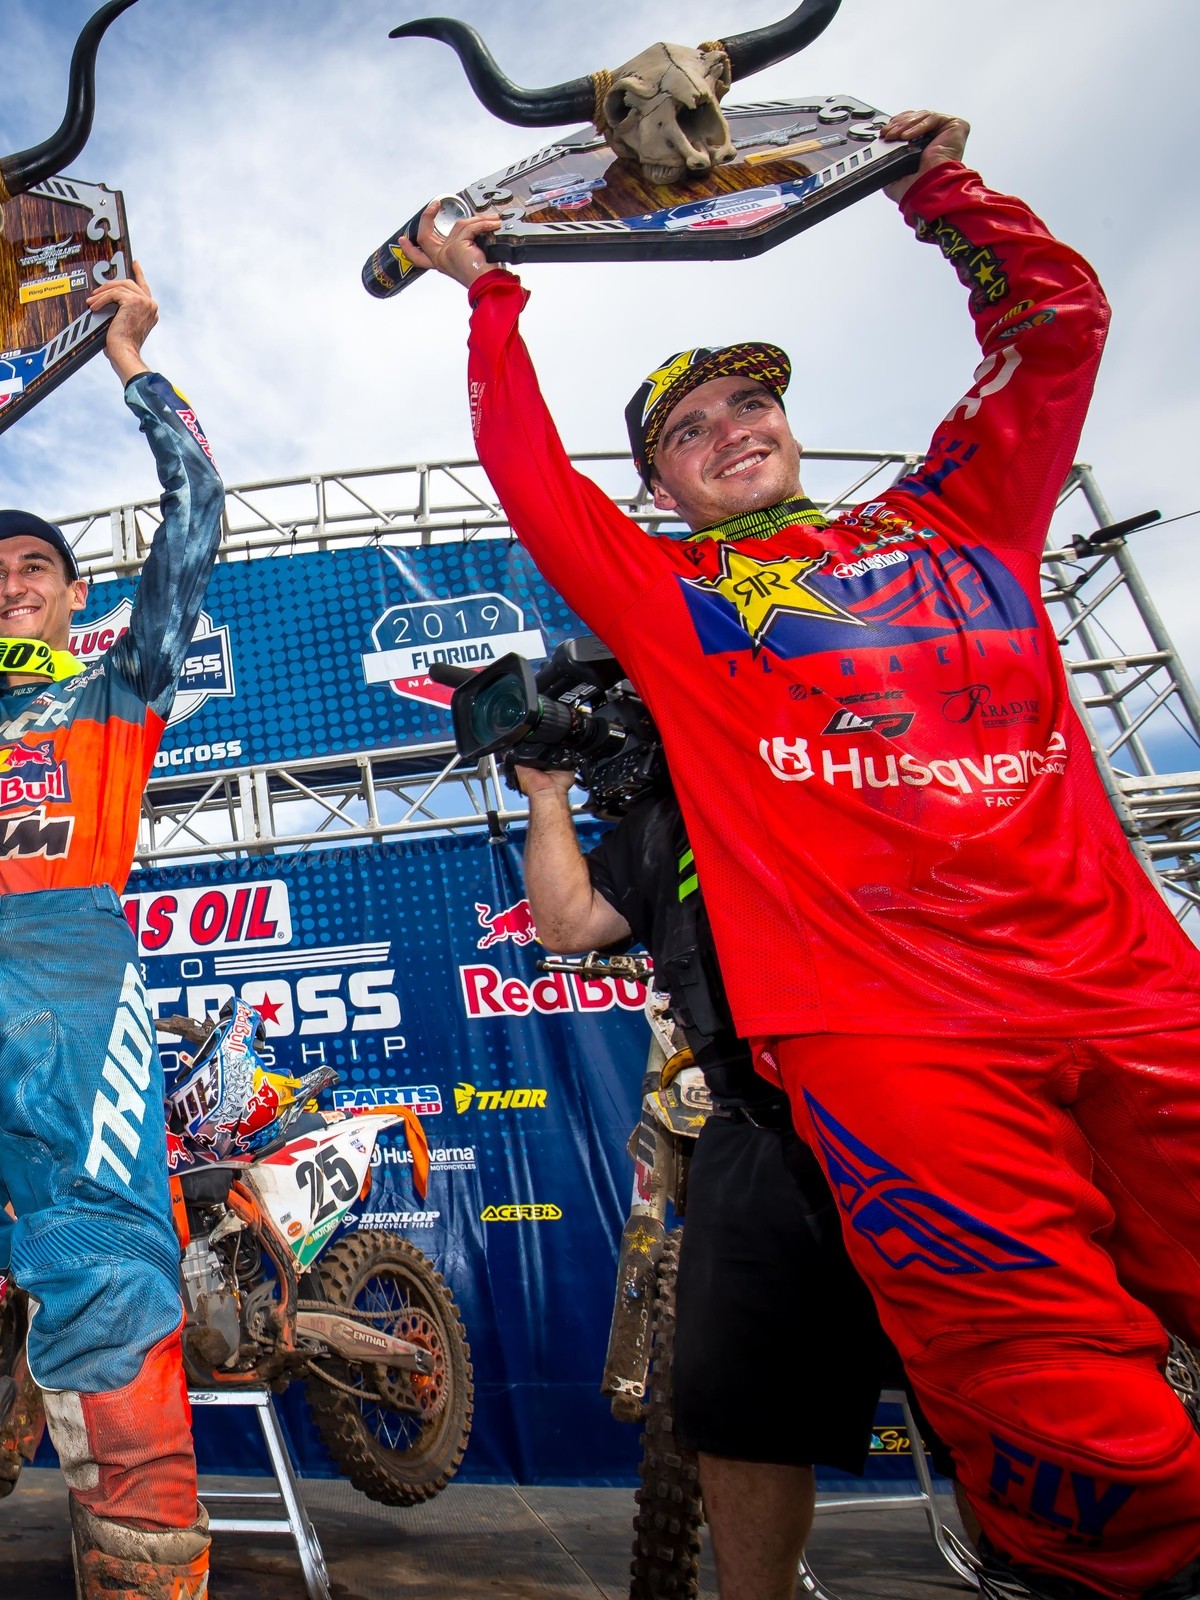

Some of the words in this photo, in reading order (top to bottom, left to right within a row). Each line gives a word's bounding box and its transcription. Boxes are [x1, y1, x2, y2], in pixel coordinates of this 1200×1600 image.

[701, 202, 763, 219] FLORIDA
[70, 277, 85, 287] CAT
[175, 408, 209, 445] Red
[392, 604, 501, 644] 2019
[69, 627, 129, 656] LUC
[411, 642, 496, 670] FLORIDA
[189, 885, 279, 946] OIL
[459, 955, 575, 1018] Red
[84, 962, 154, 1187] THOR
[334, 1086, 441, 1107] PARTS
[476, 1088, 548, 1110] THOR
[384, 1146, 475, 1165] Husvarna
[430, 1163, 477, 1171] MOTORCYCLES
[295, 1144, 359, 1226] 25
[359, 1211, 440, 1223] DUNLOP
[482, 1203, 563, 1221] ACERBIS
[358, 1222, 411, 1230] MOTORCYCLE
[411, 1221, 435, 1229] TIRES
[990, 1432, 1137, 1538] FLY
